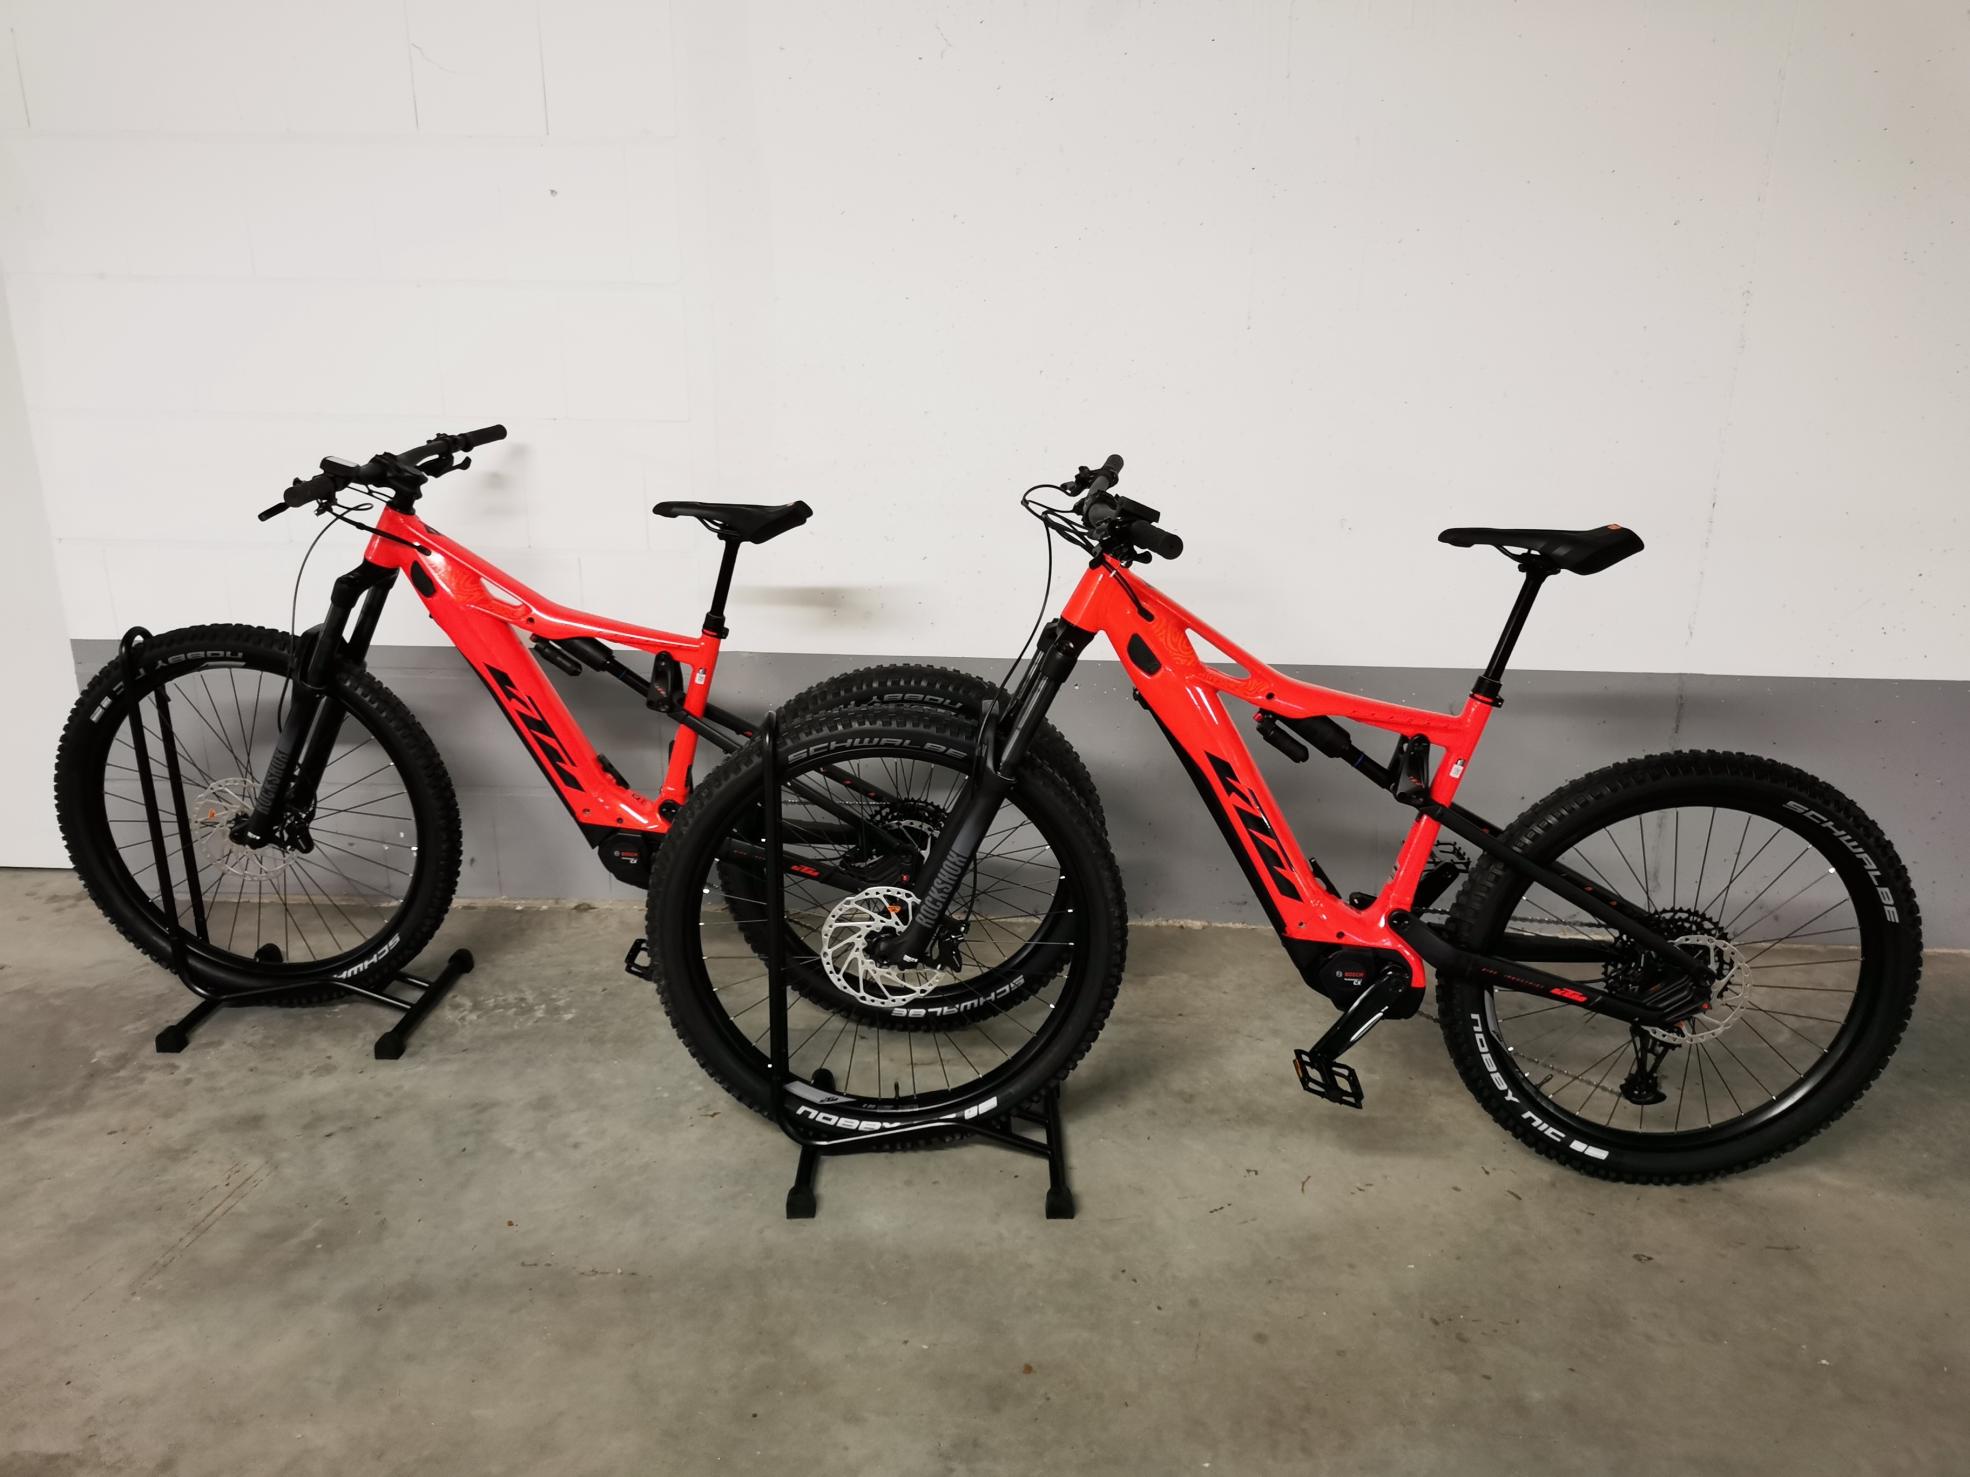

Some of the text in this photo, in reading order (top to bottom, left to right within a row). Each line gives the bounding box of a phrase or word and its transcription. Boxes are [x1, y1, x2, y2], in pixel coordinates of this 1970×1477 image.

[482, 661, 586, 793] KTM
[788, 737, 968, 763] SCHWALBE
[1204, 750, 1305, 904] KTM
[1782, 800, 1900, 924] SCHWALBE
[915, 849, 968, 929] ROCKSHOX
[332, 932, 401, 980] SCHW
[890, 973, 1026, 1018] SCHWALBE
